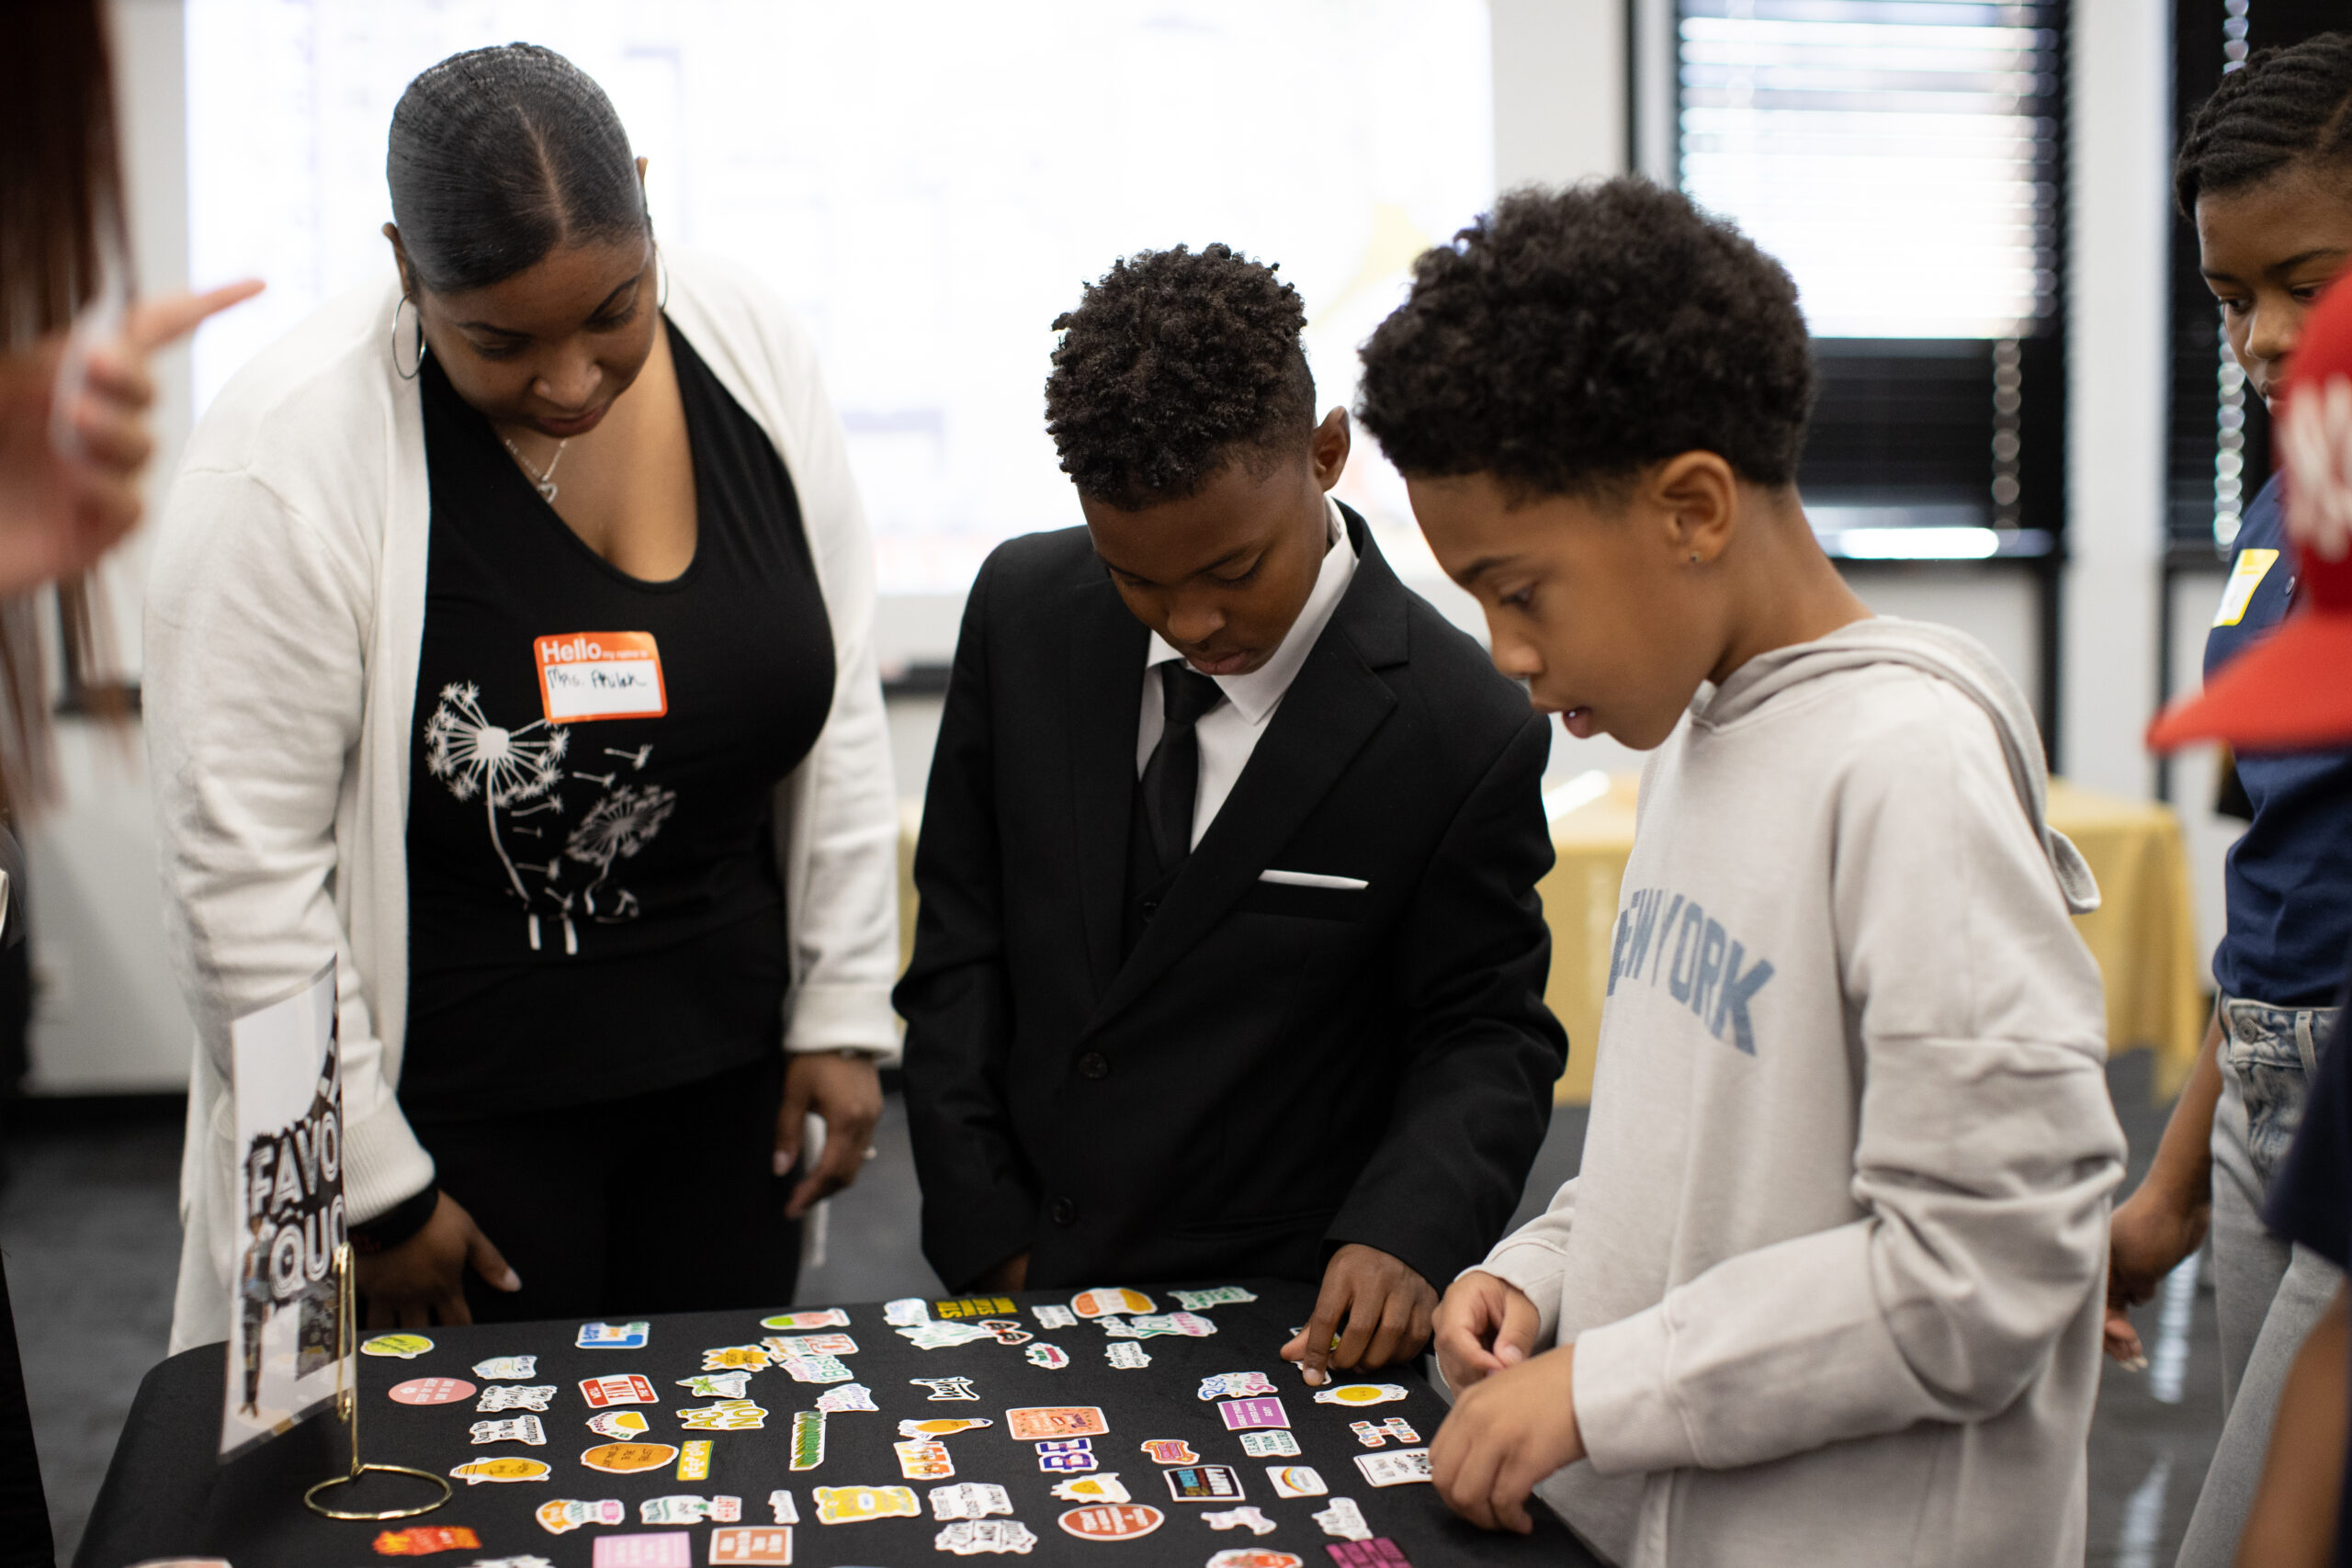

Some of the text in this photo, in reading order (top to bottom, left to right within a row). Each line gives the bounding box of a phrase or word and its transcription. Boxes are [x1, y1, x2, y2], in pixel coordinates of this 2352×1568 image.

[540, 637, 603, 663] Hello
[1651, 894, 1776, 1057] YORK
[602, 1382, 636, 1398] FIND
[1201, 1378, 1228, 1399] Rise
[680, 1408, 724, 1428] ACT
[718, 1400, 765, 1428] NOW
[1038, 1439, 1092, 1471] BE
[1260, 1436, 1278, 1451] FROM
[1204, 1468, 1233, 1495] HAPPY
